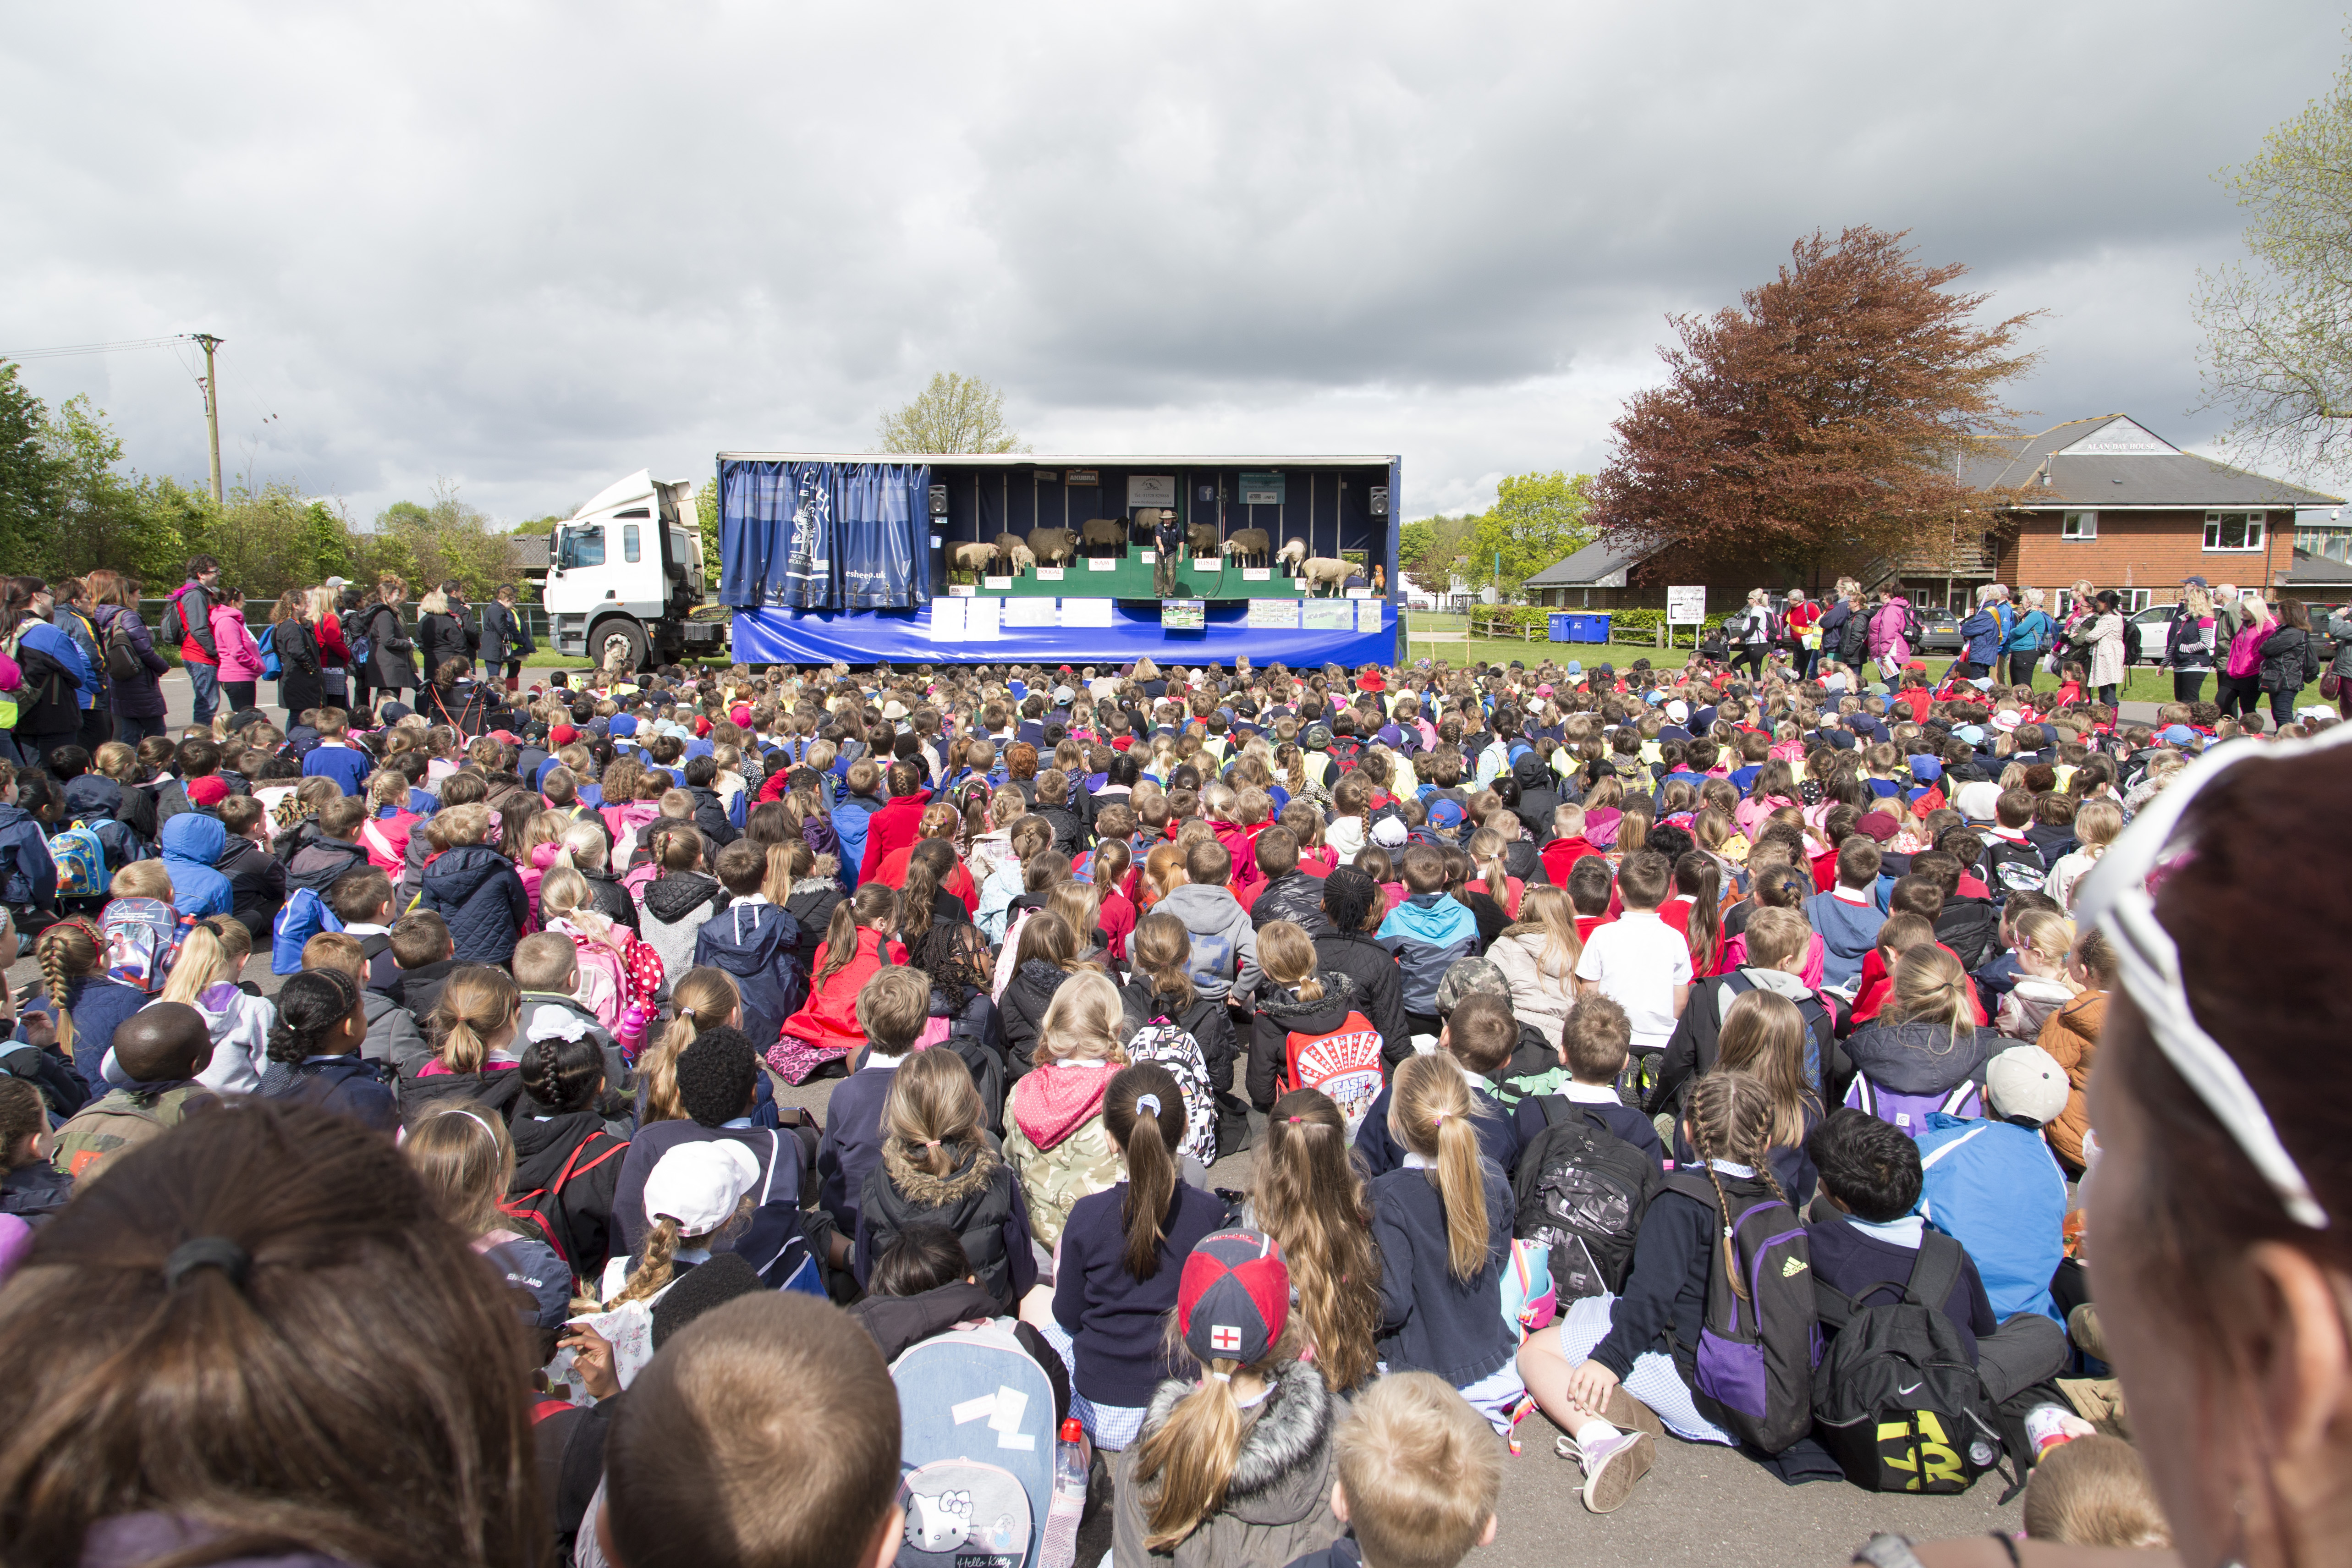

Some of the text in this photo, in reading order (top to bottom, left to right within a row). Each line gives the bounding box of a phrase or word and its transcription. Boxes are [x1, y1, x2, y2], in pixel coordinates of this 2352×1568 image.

[845, 570, 886, 581] esheep.uk
[1332, 1074, 1369, 1095] EAST
[1335, 1087, 1367, 1103] HIGH
[1782, 1262, 1808, 1278] adidas
[506, 1273, 543, 1288] ENGLAND
[957, 1555, 1012, 1568] Hello Kitty
